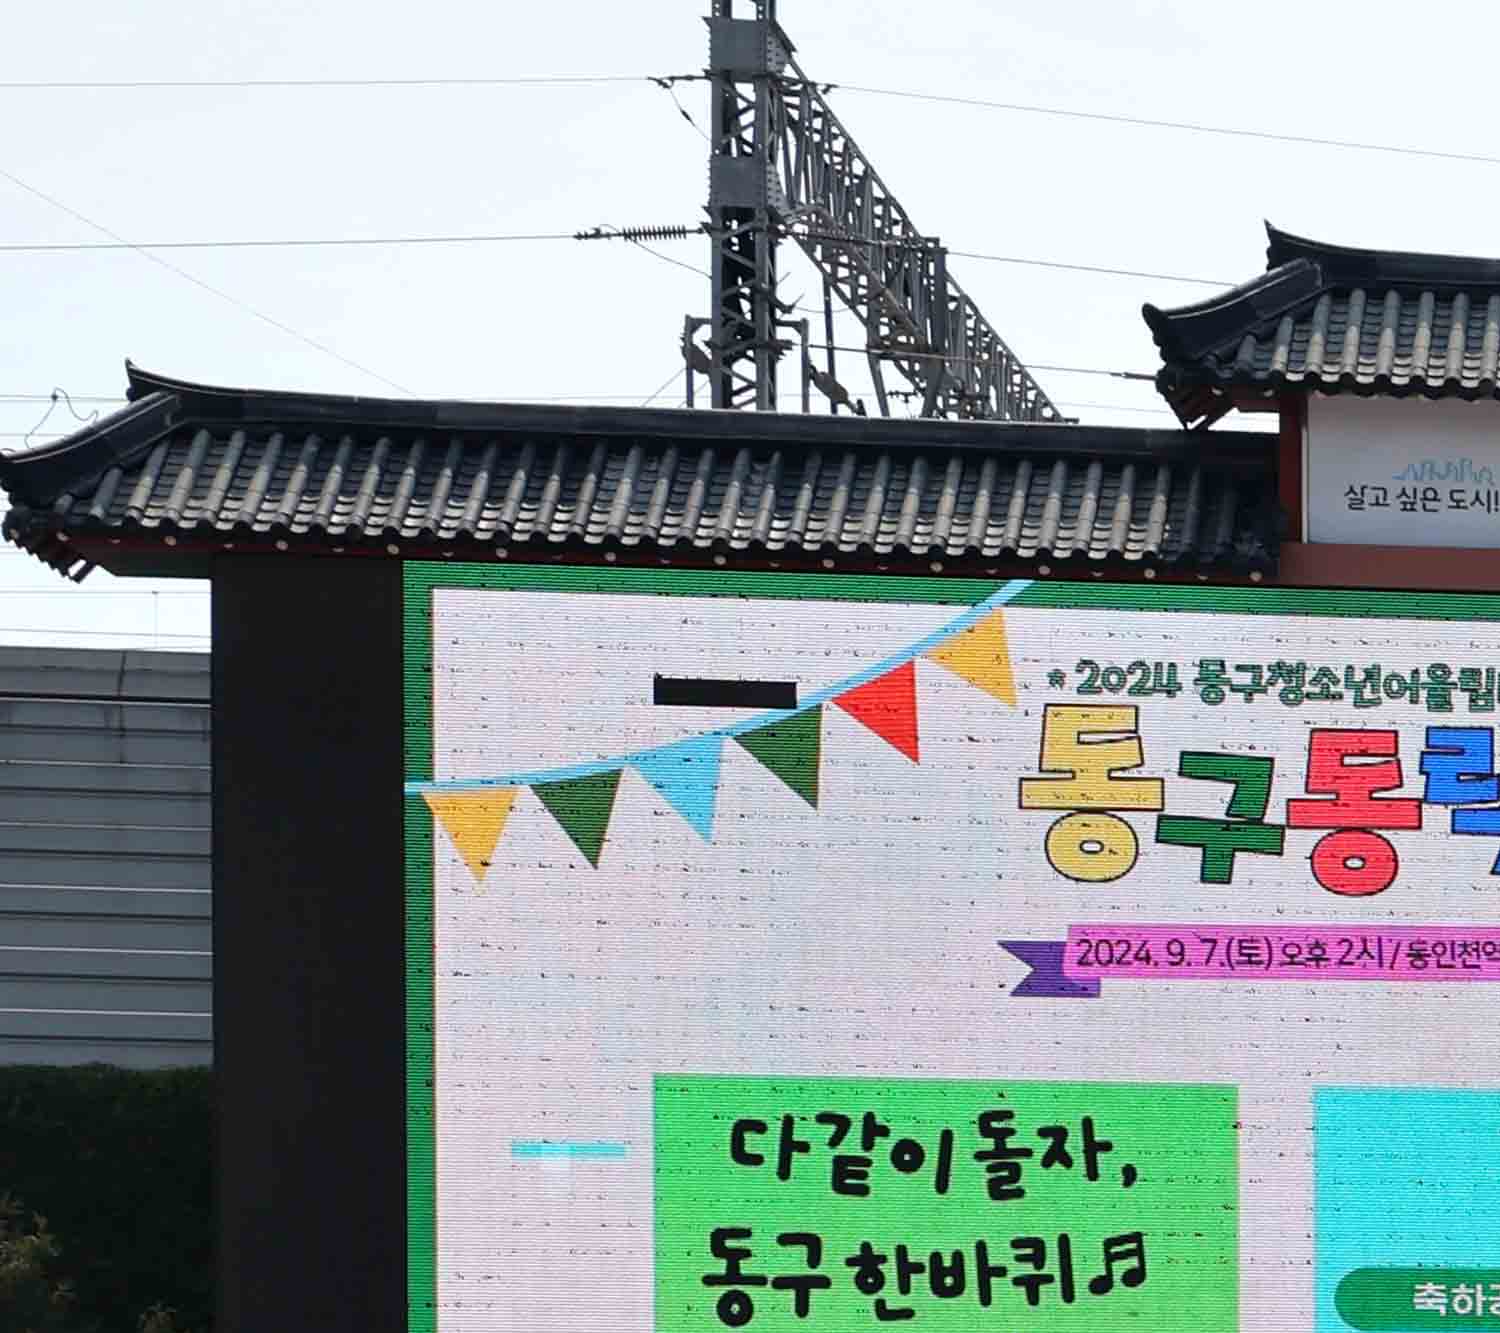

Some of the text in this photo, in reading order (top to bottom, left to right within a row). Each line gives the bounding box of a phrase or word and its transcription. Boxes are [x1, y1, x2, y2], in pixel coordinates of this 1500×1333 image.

[1344, 486, 1500, 513] 살고 싶은 도시!
[1075, 659, 1183, 698] 2024
[1077, 939, 1158, 968] 2024.
[1166, 939, 1196, 968] 9.
[1279, 941, 1330, 969] 오후
[1337, 938, 1385, 970] 2시
[730, 1110, 1138, 1201] 다같이 돌자,
[701, 1227, 1076, 1328] 동구 한바퀴
